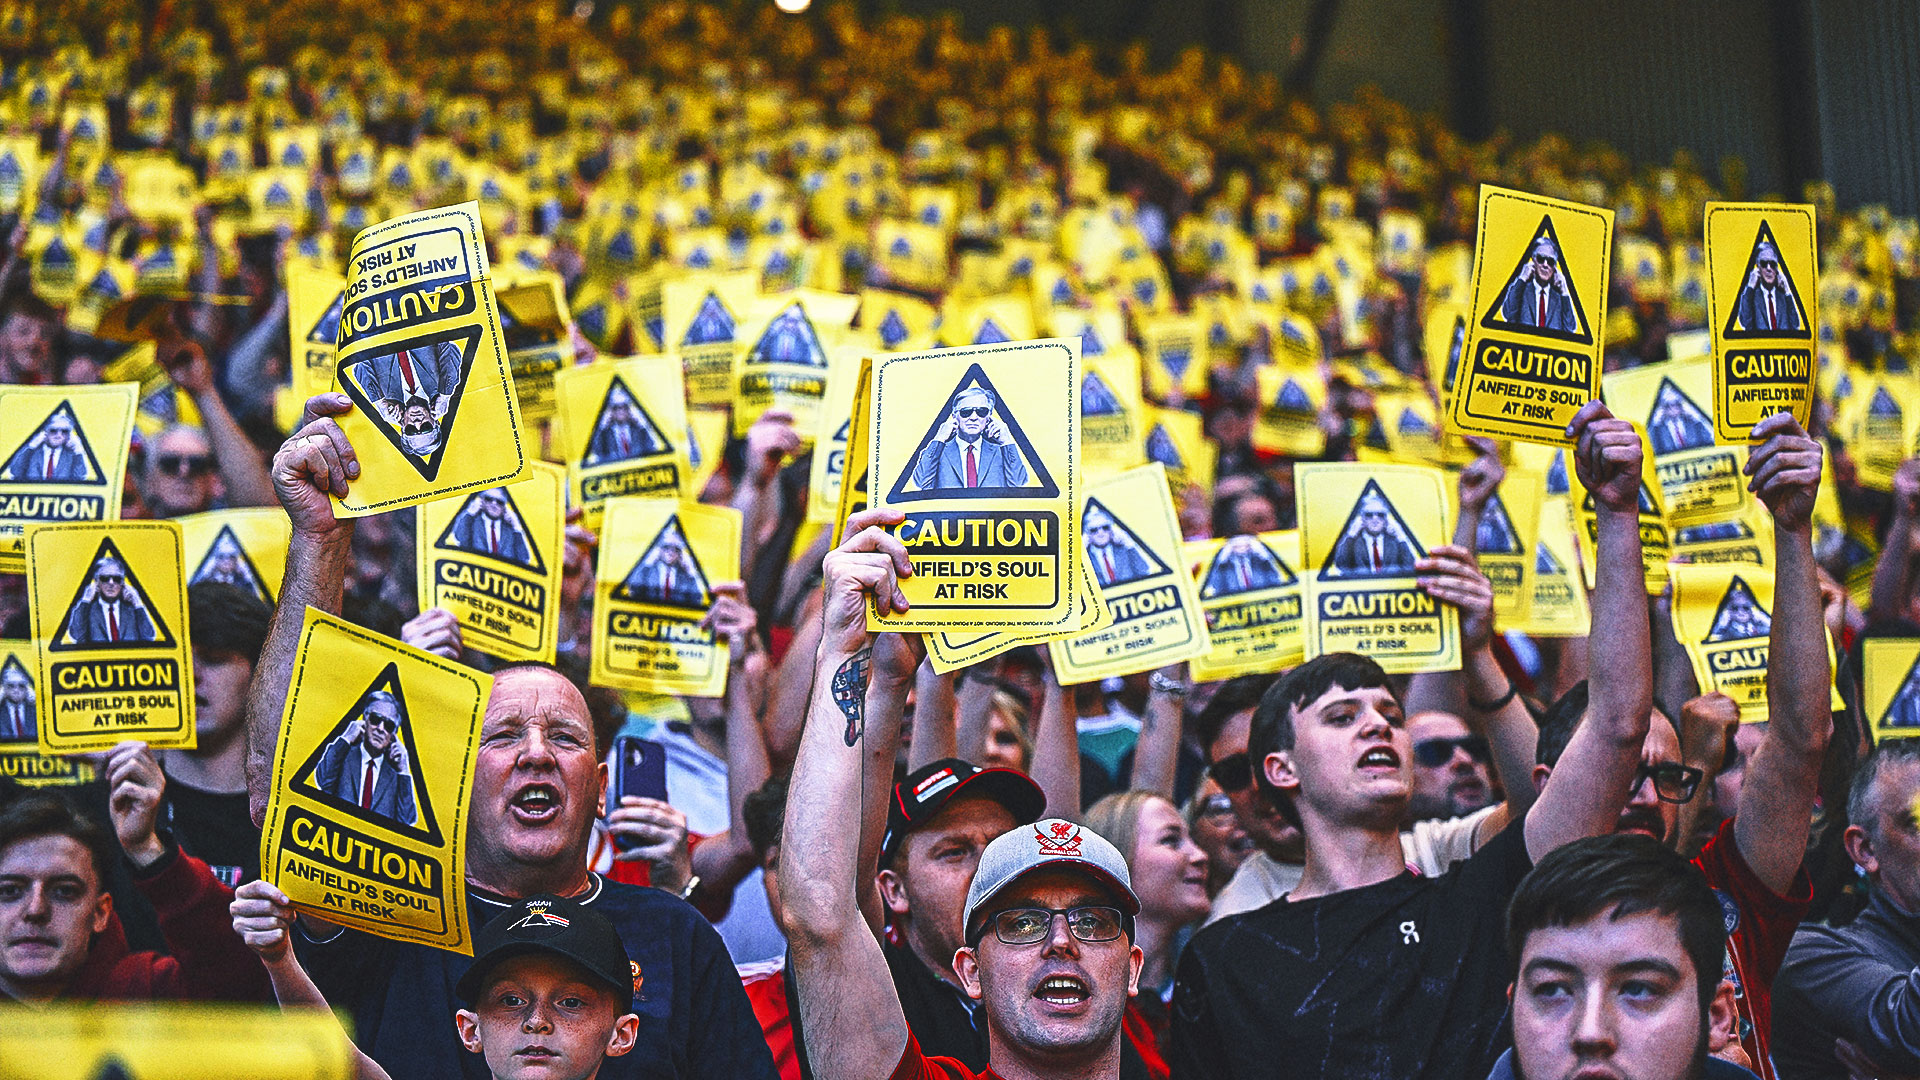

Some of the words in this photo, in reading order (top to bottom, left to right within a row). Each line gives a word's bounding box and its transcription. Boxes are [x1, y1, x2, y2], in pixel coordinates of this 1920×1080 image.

[357, 250, 393, 275] RISK
[396, 243, 417, 263] AT
[372, 255, 458, 289] ANFIELD'S
[340, 283, 466, 344] CAUTION
[882, 361, 890, 369] THE
[1482, 345, 1587, 384] CAUTION
[1731, 355, 1808, 379] CAUTION
[1476, 379, 1547, 402] ANFIELD'S
[1550, 389, 1585, 408] SOUL
[1732, 388, 1790, 404] ANFIELD'S
[1501, 401, 1521, 415] AT
[1522, 403, 1555, 421] RISK
[1760, 405, 1775, 418] AT
[585, 468, 674, 496] CAUTION
[1656, 457, 1734, 485] AUTION
[893, 517, 1048, 547] CAUTION
[909, 560, 993, 578] NFIELD'S
[997, 560, 1050, 578] SOUL
[439, 562, 541, 609] CAUTION
[934, 584, 959, 599] AT
[963, 584, 1009, 600] RISK
[443, 590, 505, 618] ANFIELD'S
[871, 609, 879, 620] THE
[1110, 587, 1177, 622] TION
[1323, 591, 1435, 617] CAUTION
[1713, 647, 1769, 671] CAUT
[58, 662, 173, 690] CAUTION
[61, 695, 136, 713] ANFIELD'S
[139, 695, 175, 708] SOUL
[94, 713, 111, 727] AT
[115, 711, 148, 726] RISK
[291, 817, 432, 890] CAUTION
[284, 858, 379, 901] ANFIELD'S
[382, 889, 436, 914] SOUL
[321, 891, 347, 909] AT
[350, 899, 397, 921] RISK
